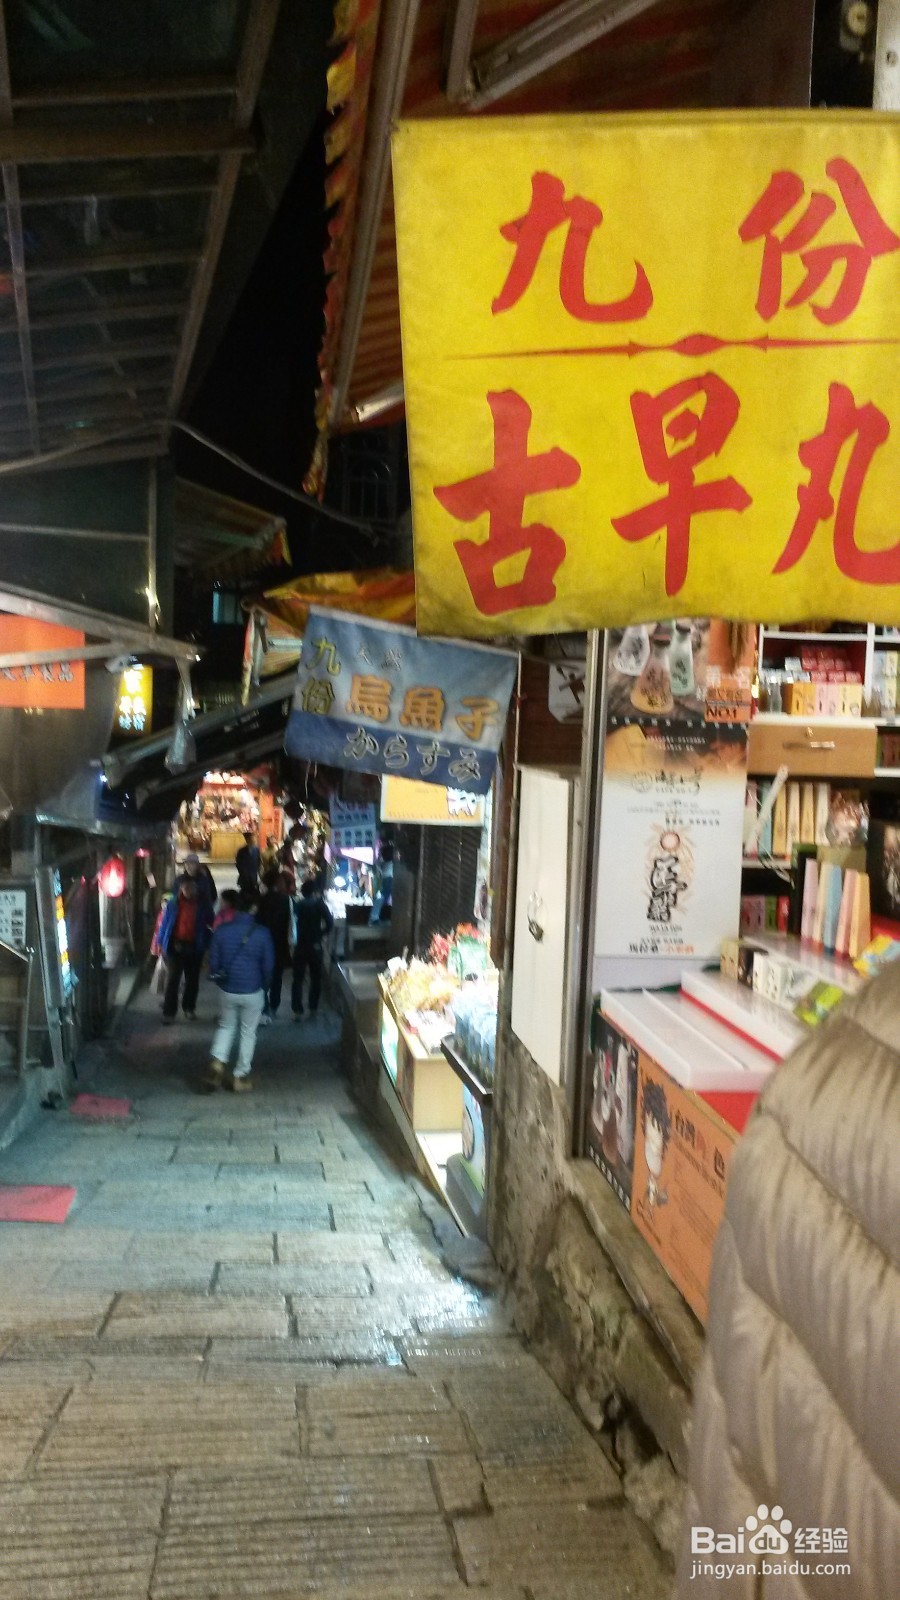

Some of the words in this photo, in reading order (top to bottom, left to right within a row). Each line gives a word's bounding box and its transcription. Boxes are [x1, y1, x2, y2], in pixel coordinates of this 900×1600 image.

[491, 156, 900, 326] 九份
[433, 371, 900, 616] 古早丸
